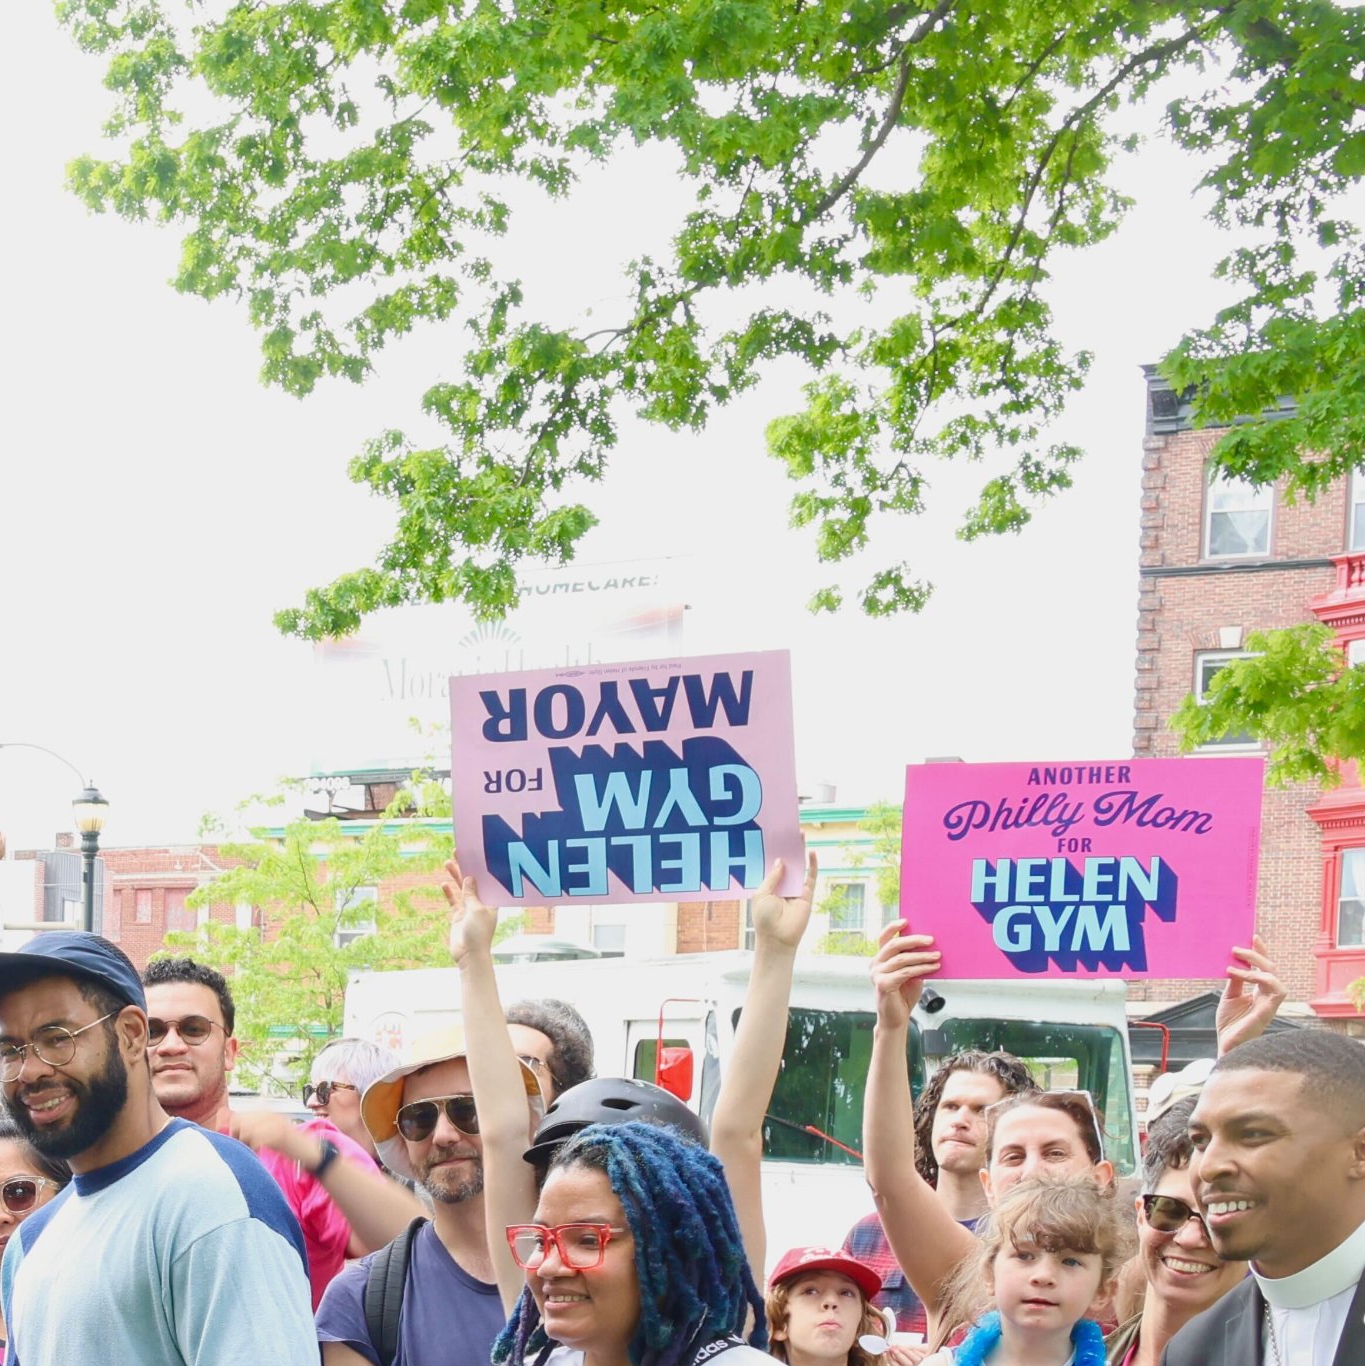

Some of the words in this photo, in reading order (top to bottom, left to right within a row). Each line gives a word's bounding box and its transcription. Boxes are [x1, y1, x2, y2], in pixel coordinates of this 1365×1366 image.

[479, 670, 753, 742] MAYOR
[484, 768, 542, 794] FOR
[574, 764, 762, 832] GYM
[1027, 766, 1131, 785] ANOTHER
[943, 792, 1085, 841] Philly
[1093, 791, 1213, 835] Mom
[507, 830, 764, 898] HELEN
[1058, 838, 1092, 853] FOR
[970, 856, 1161, 903] HELEN
[992, 905, 1131, 953] GYM
